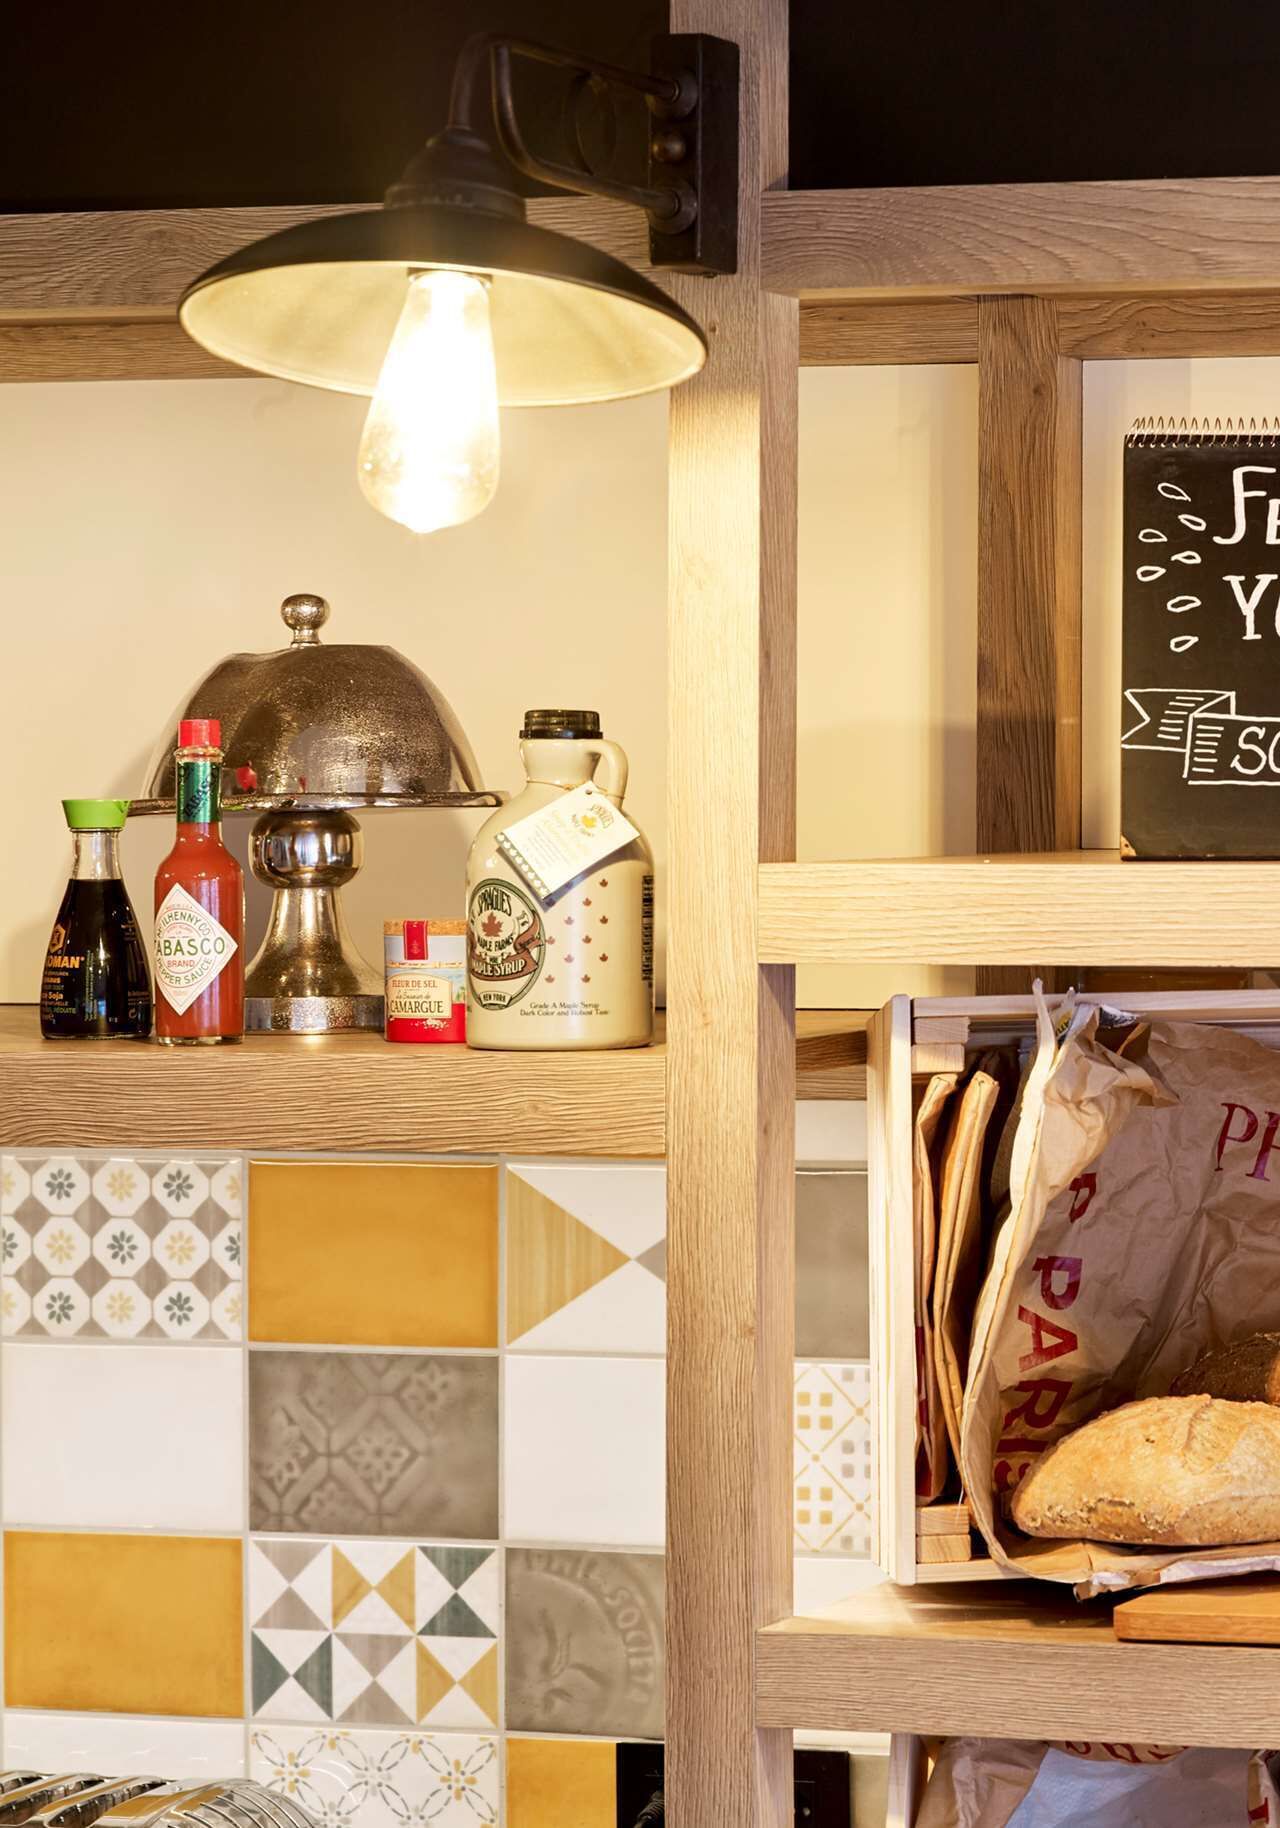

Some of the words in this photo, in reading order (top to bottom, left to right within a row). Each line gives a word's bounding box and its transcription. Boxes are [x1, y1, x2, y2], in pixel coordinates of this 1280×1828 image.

[166, 959, 195, 968] BRAND
[495, 958, 526, 977] SYRUP
[182, 958, 212, 985] SAUCE
[411, 980, 422, 988] DE
[425, 980, 438, 988] SEL
[390, 1000, 445, 1014] CAMARGUE
